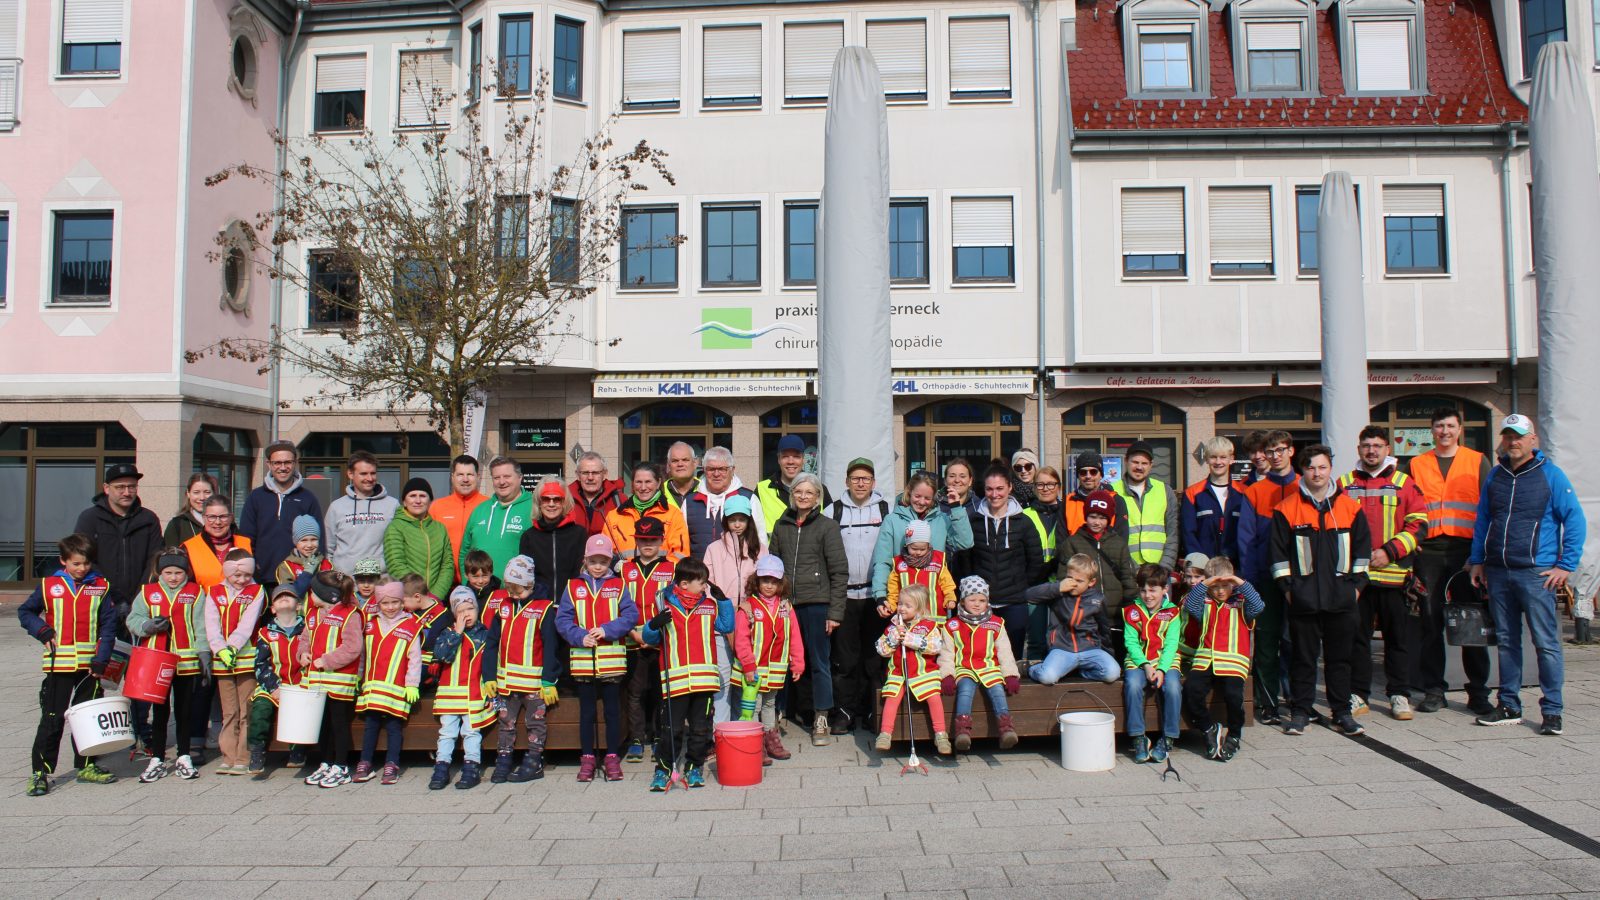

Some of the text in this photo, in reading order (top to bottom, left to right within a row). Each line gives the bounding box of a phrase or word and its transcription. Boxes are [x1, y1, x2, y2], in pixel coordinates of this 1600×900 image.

[890, 301, 940, 315] erneck
[775, 334, 943, 351] chirur opädie
[1136, 376, 1176, 385] Gelateria
[1368, 373, 1398, 382] lateria
[625, 385, 654, 393] Technik
[658, 383, 694, 395] KAHL
[697, 385, 741, 394] Orthopädie
[748, 384, 801, 393] Schuhtechnik
[892, 380, 918, 392] AHL
[922, 382, 967, 391] Orthopädie
